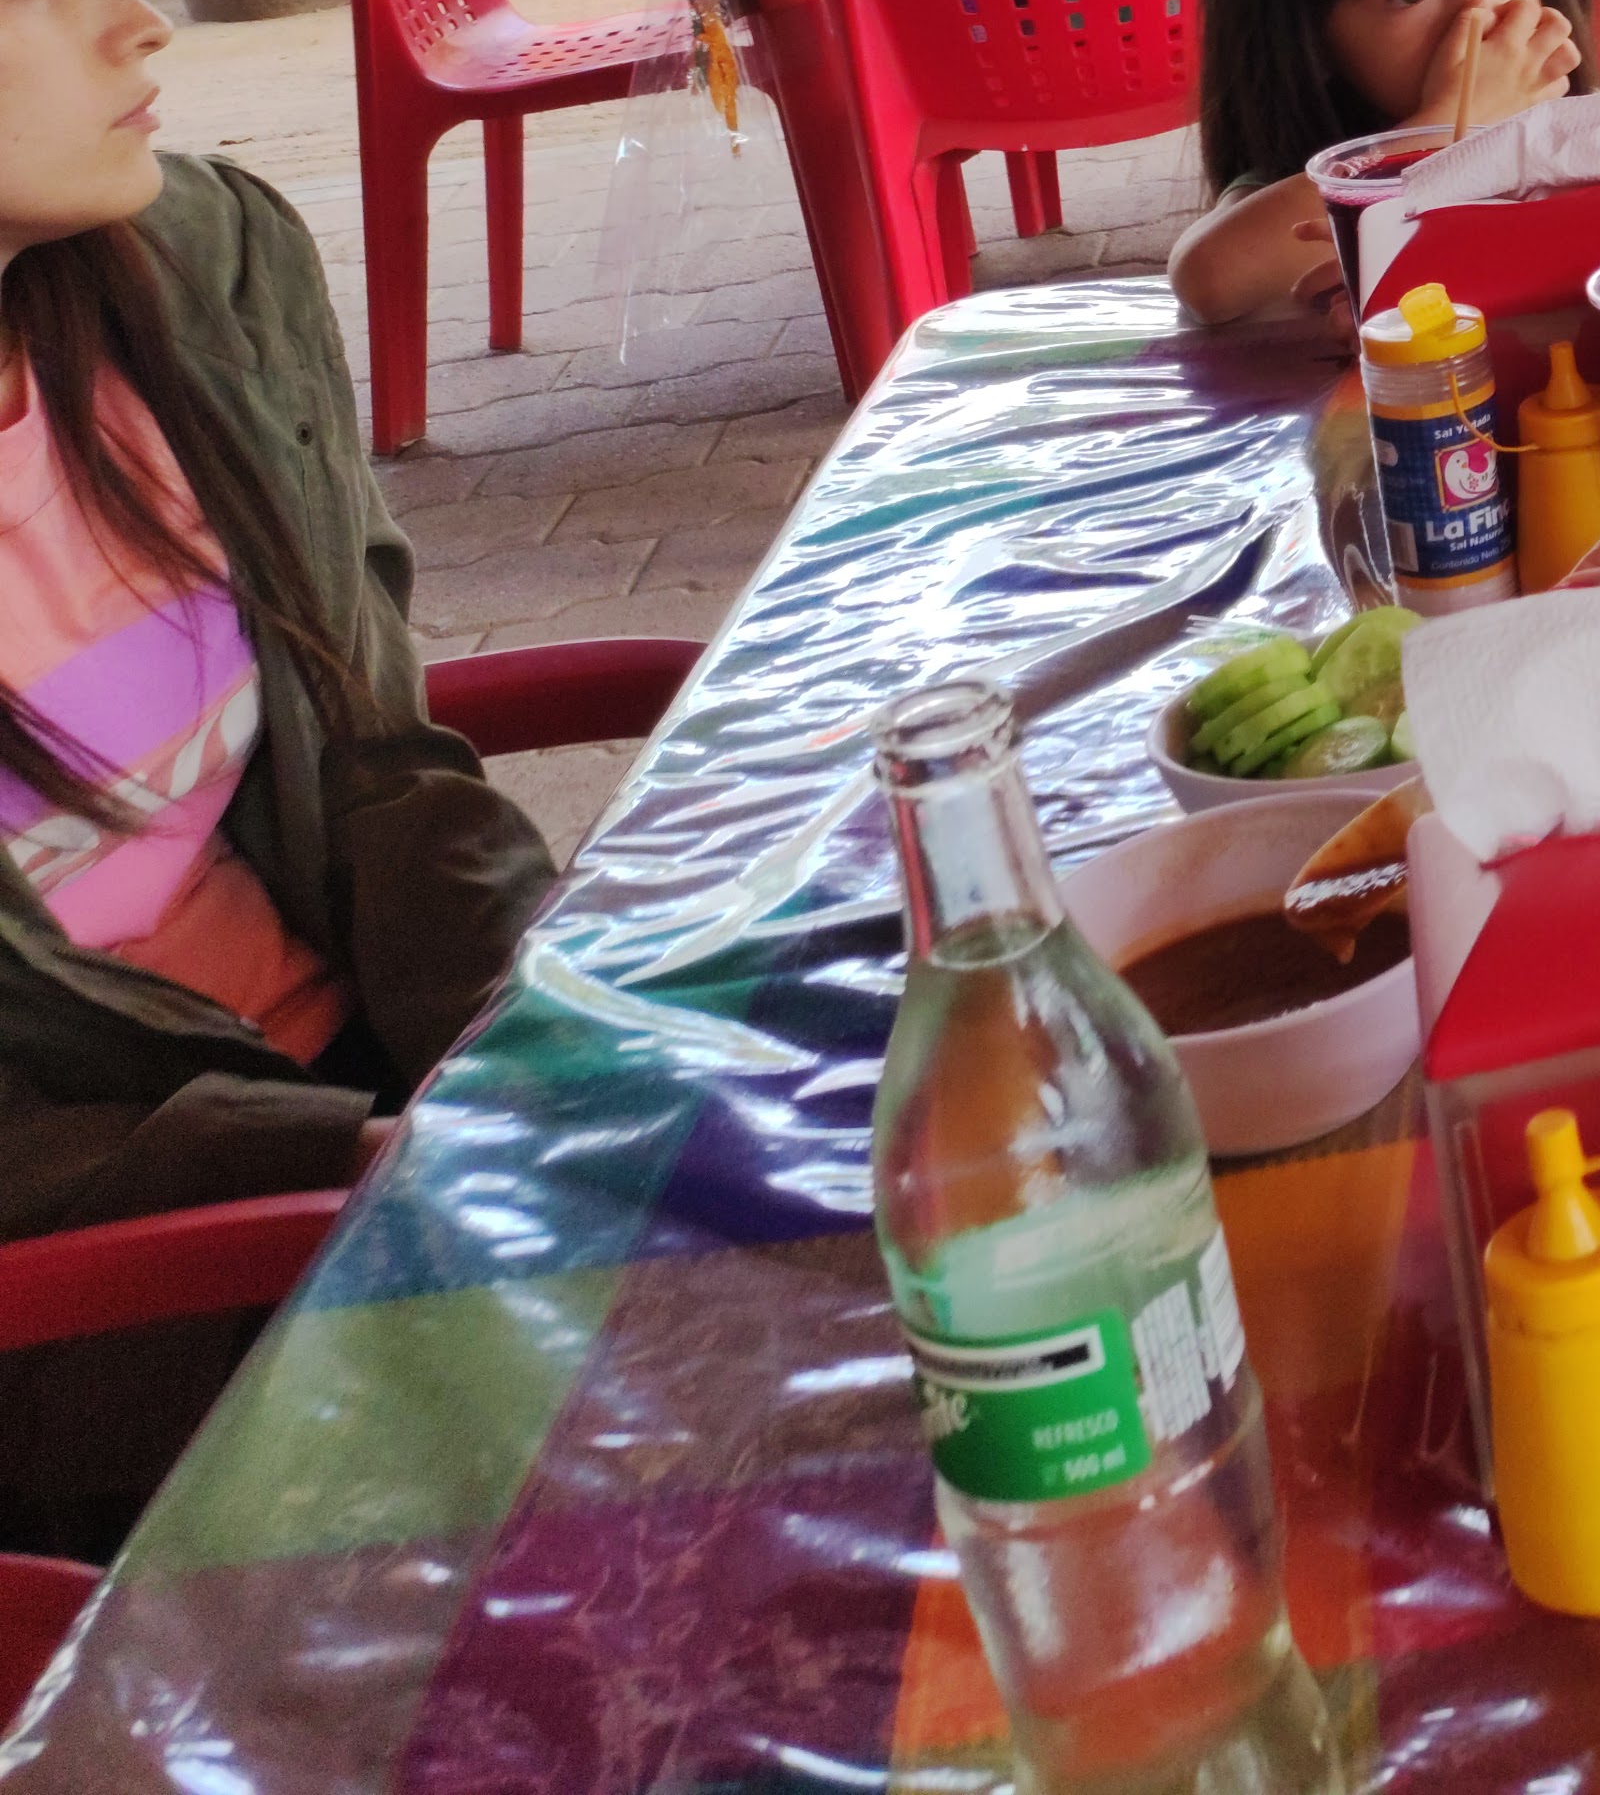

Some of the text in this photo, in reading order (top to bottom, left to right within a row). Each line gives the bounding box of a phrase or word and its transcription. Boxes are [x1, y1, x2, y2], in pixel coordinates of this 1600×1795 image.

[1434, 427, 1453, 440] Sal
[1425, 519, 1465, 542] La
[1449, 539, 1467, 553] Sal
